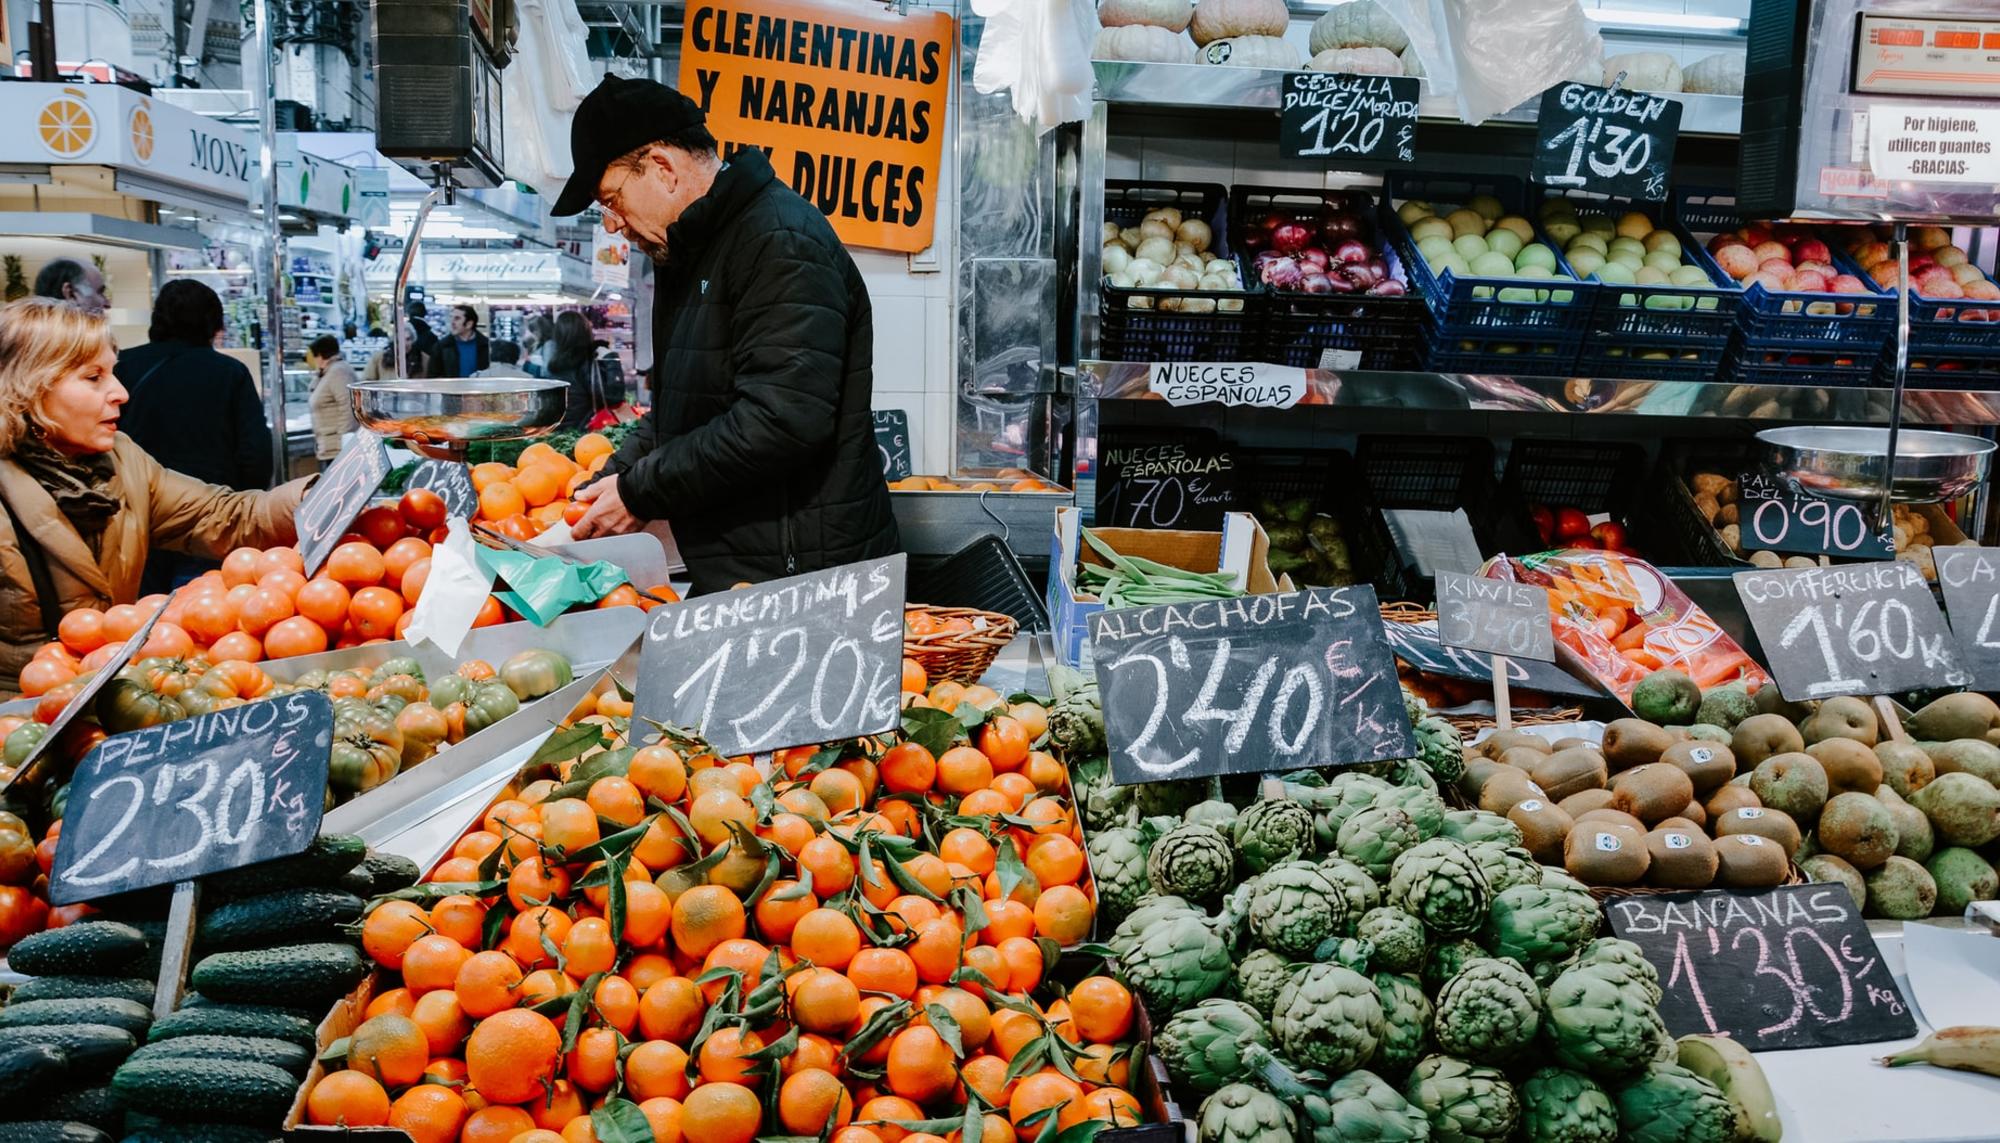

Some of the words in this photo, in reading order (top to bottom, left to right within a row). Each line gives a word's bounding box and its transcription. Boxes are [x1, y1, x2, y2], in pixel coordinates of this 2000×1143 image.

[692, 7, 940, 85] CLEMENTINAS
[696, 68, 720, 113] Y
[739, 75, 930, 144] NARANJAS
[1560, 84, 1668, 124] GOLDEN
[1904, 116, 1923, 131] Por
[1928, 117, 1978, 133] higiene,
[1299, 108, 1384, 155] 1'20
[1545, 116, 1650, 187] 1'30
[1888, 139, 1936, 153] utilicen
[1939, 139, 1991, 154] guantes
[792, 151, 924, 227] DULCES
[1907, 160, 1969, 175] -GRACIAS-
[1156, 363, 1254, 384] NUECES
[1167, 383, 1292, 405] ESPAÑOLAS
[1105, 445, 1186, 467] NUECES
[1120, 453, 1234, 478] ESPAÑOLAS
[1744, 488, 1783, 500] DEL
[1753, 500, 1866, 550] 0'90
[1444, 576, 1533, 607] KIWIS
[1096, 588, 1355, 644] ALCACHOFAS
[1778, 599, 1914, 696] 1'60
[673, 627, 865, 749] 1'20
[1107, 636, 1323, 773] 2'40
[94, 695, 309, 774] PEPINOS
[60, 759, 265, 886] 2'30
[1614, 891, 1848, 934] BANANAS
[1668, 926, 1852, 1037] 1'30
